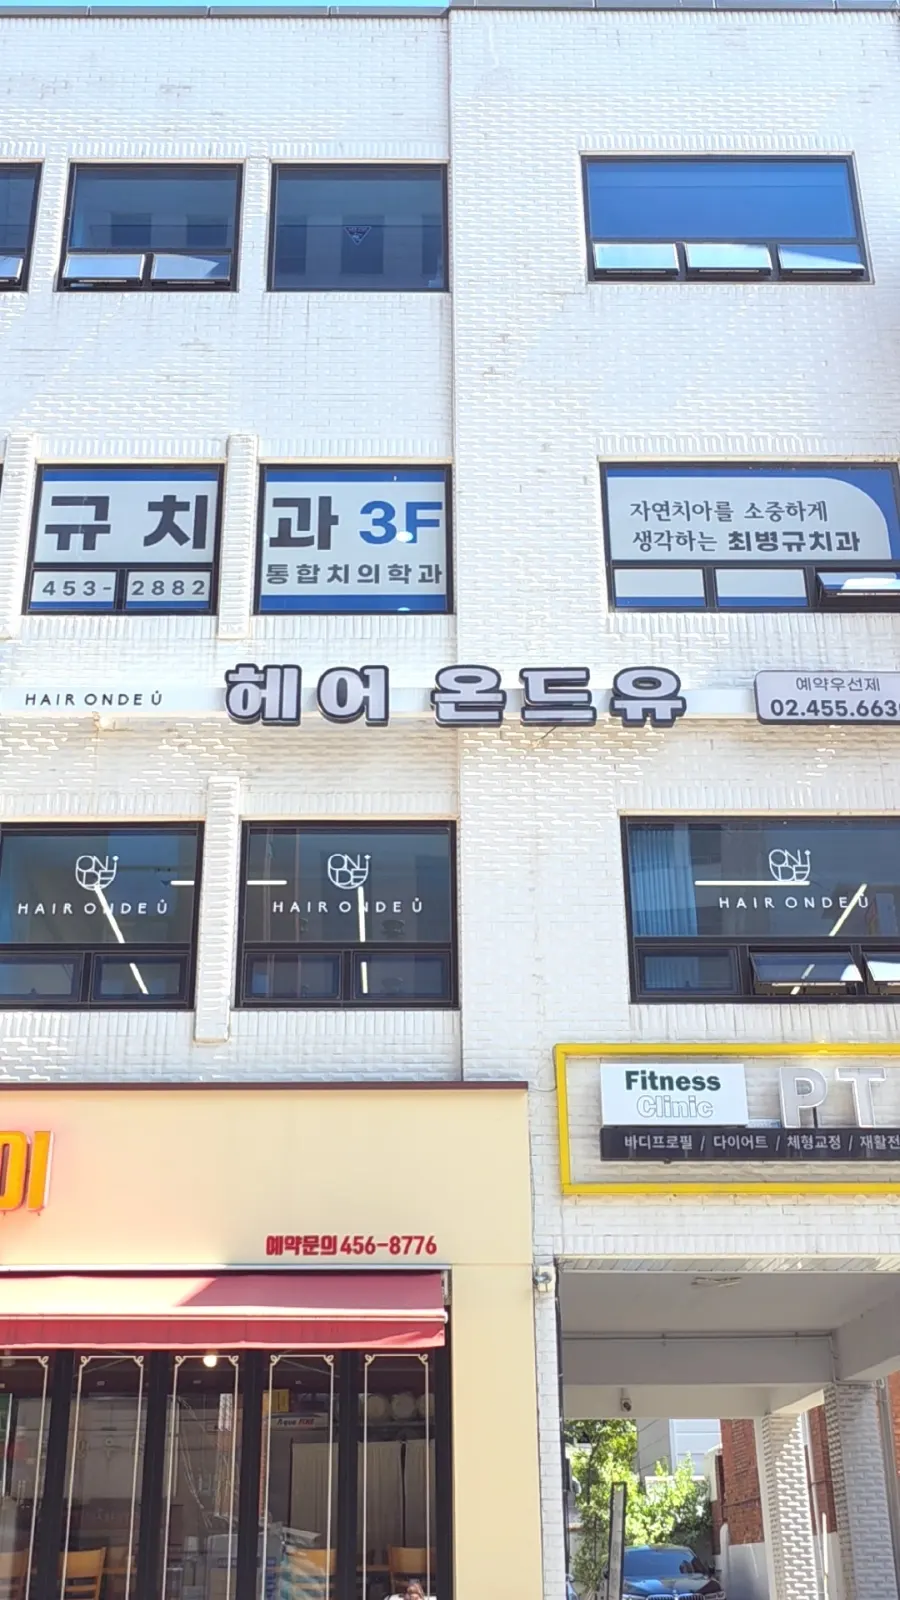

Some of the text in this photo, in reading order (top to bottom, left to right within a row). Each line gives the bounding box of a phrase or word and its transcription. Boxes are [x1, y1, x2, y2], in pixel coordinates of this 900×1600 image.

[630, 500, 828, 523] 자연치아를 소중하게
[632, 530, 861, 552] 생각하는 최병규치과
[266, 563, 442, 585] 통합치의학과
[795, 676, 881, 692] 예약우선제
[25, 693, 75, 706] HAIR
[770, 699, 900, 717] 02.455.663
[17, 902, 73, 915] HAIR
[272, 901, 328, 913] HAIR
[719, 897, 775, 909] HAIR
[625, 1070, 721, 1091] Fitness
[636, 1095, 714, 1118] Clinic
[779, 1067, 886, 1129] PT
[624, 1134, 693, 1151] 바디프로필
[713, 1135, 769, 1151] 다이어트
[786, 1134, 841, 1150] 체형교정
